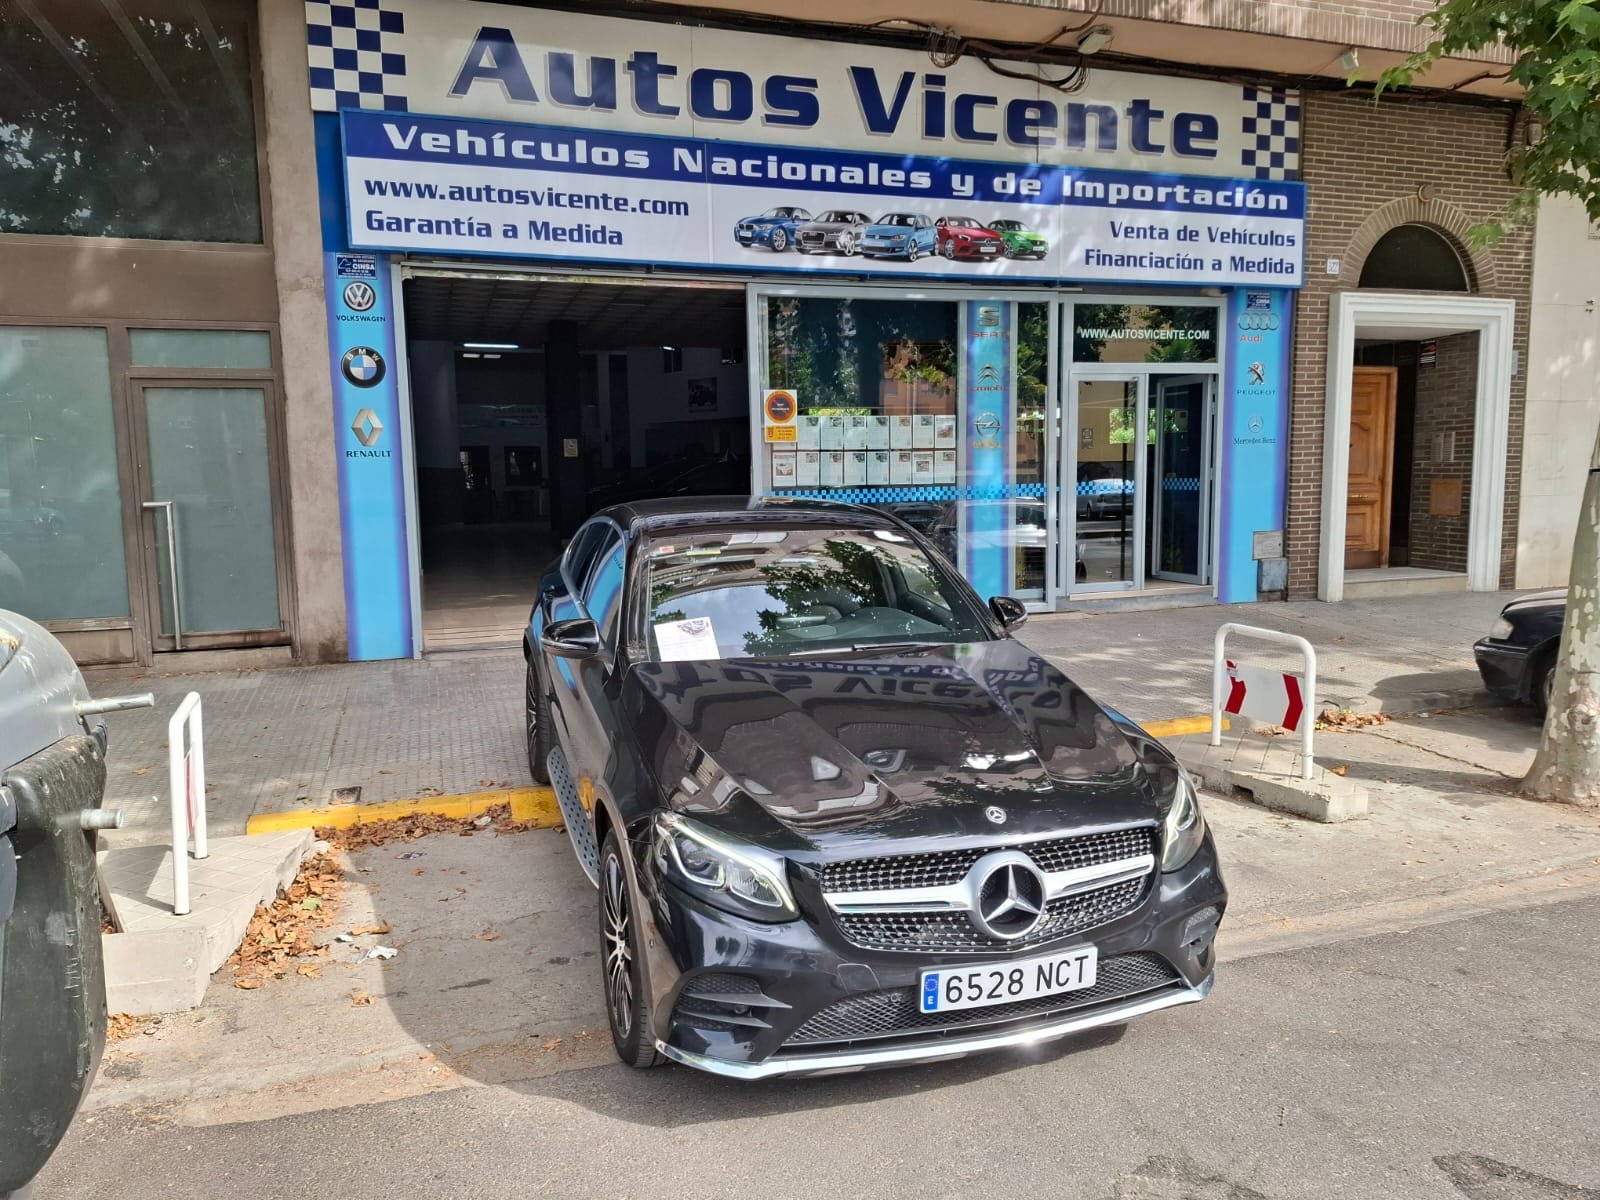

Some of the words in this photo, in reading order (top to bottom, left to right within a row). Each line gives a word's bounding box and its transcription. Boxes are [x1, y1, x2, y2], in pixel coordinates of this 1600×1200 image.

[448, 27, 820, 128] Autos
[848, 66, 1219, 158] Vicente
[382, 123, 650, 169] Vehículos
[673, 147, 931, 189] Nacionales
[951, 174, 974, 197] y
[993, 173, 1042, 196] de
[1062, 176, 1289, 210] Importación
[364, 178, 690, 216] www.autosvicente.com
[365, 210, 492, 237] Garantía
[502, 220, 519, 238] a
[528, 222, 624, 245] Medida
[1110, 221, 1170, 243] Venta
[1176, 225, 1201, 243] de
[1207, 226, 1296, 247] Vehículos
[1085, 249, 1204, 271] Financiación
[1211, 259, 1223, 272] a
[1229, 256, 1296, 275] Medida
[336, 314, 386, 323] VOLKSWAGEN
[1080, 328, 1210, 341] WWW.AUTOSVICENTE.COM
[1239, 334, 1264, 344] Audi
[346, 450, 392, 458] RENAULT
[944, 967, 1024, 1005] 6528
[1036, 954, 1090, 993] NCT
[927, 996, 934, 1005] E
